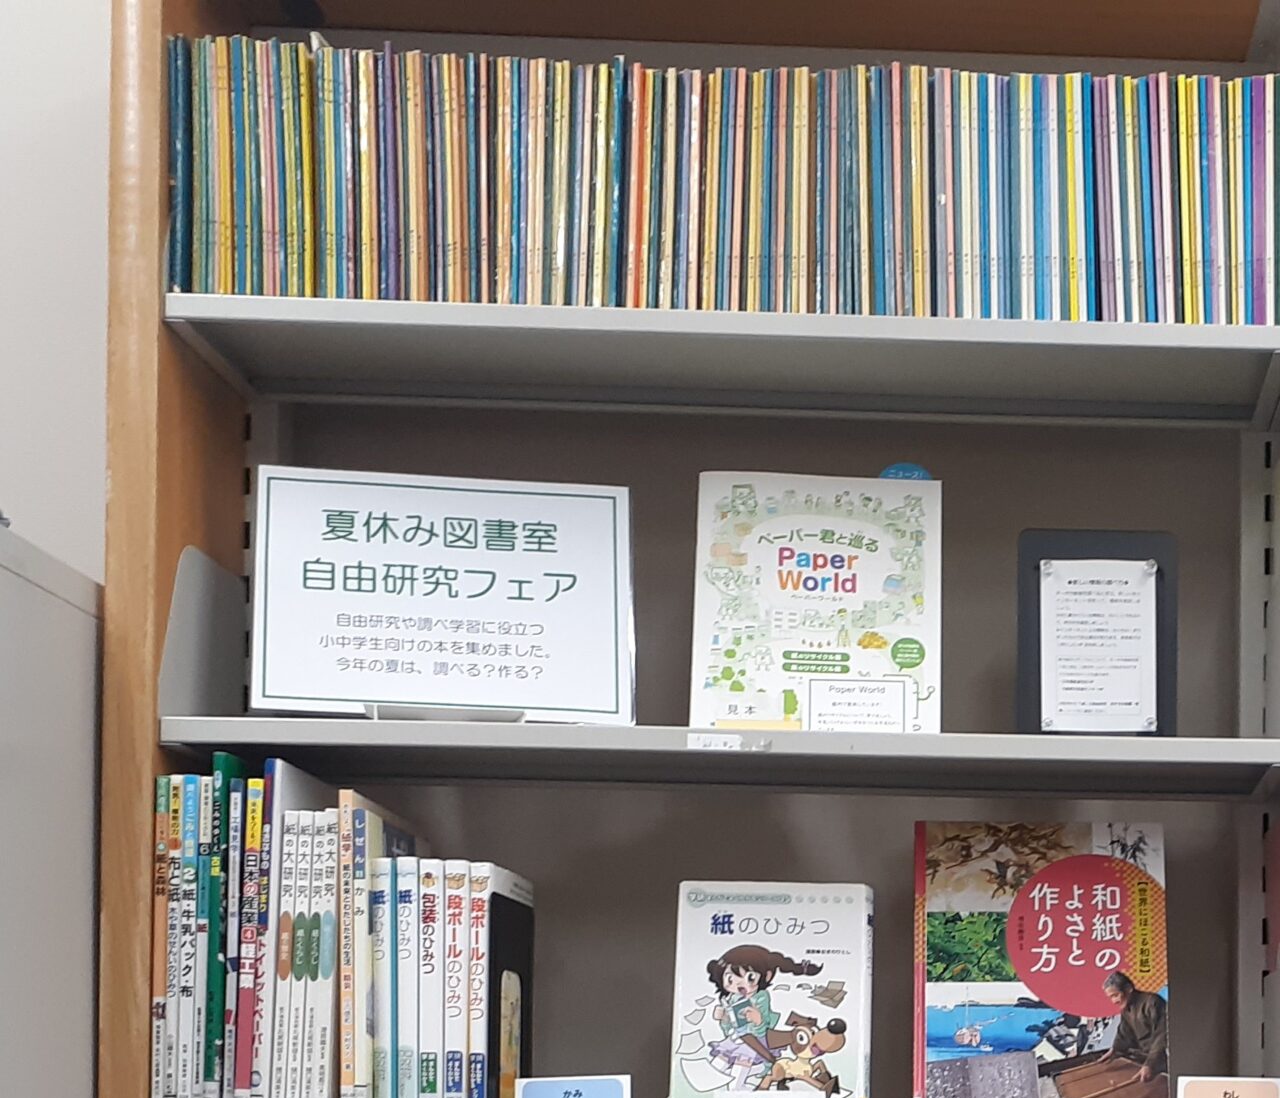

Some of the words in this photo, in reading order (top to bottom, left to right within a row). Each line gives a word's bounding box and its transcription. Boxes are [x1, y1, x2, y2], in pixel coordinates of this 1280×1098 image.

[321, 508, 558, 554] 夏休み図書室
[757, 528, 880, 553] ペーパー君と巡る
[778, 547, 859, 571] Paper
[302, 557, 578, 603] 自由研究フェア
[777, 570, 857, 594] World
[318, 635, 552, 660] 小中学生向けの本を集めました。
[335, 612, 546, 637] 自由研究や調べ学習に役立つ
[727, 704, 757, 716] 見本
[828, 685, 856, 696] Paper
[859, 685, 886, 694] World
[283, 823, 297, 898] 紙の大研究
[297, 824, 312, 898] 紙の大研究
[312, 825, 325, 899] 紙の大研究
[325, 823, 338, 897] 紙の大研究
[355, 819, 365, 863] しぜん
[354, 887, 365, 916] かみ
[372, 889, 387, 961] 紙のひみつ
[398, 889, 413, 961] 紙のひみつ
[709, 912, 831, 936] 紙のひみつ
[1029, 883, 1061, 973] 作り方
[1064, 884, 1087, 966] よさと
[1090, 883, 1123, 971] 和紙の
[180, 888, 197, 997] 紙・牛乳パック・布
[421, 893, 438, 975] 包装のひみつ
[446, 894, 463, 1019] 段ボールのひみつ
[470, 897, 486, 1021] 段ボールのひみつ
[562, 1089, 583, 1098] かみ
